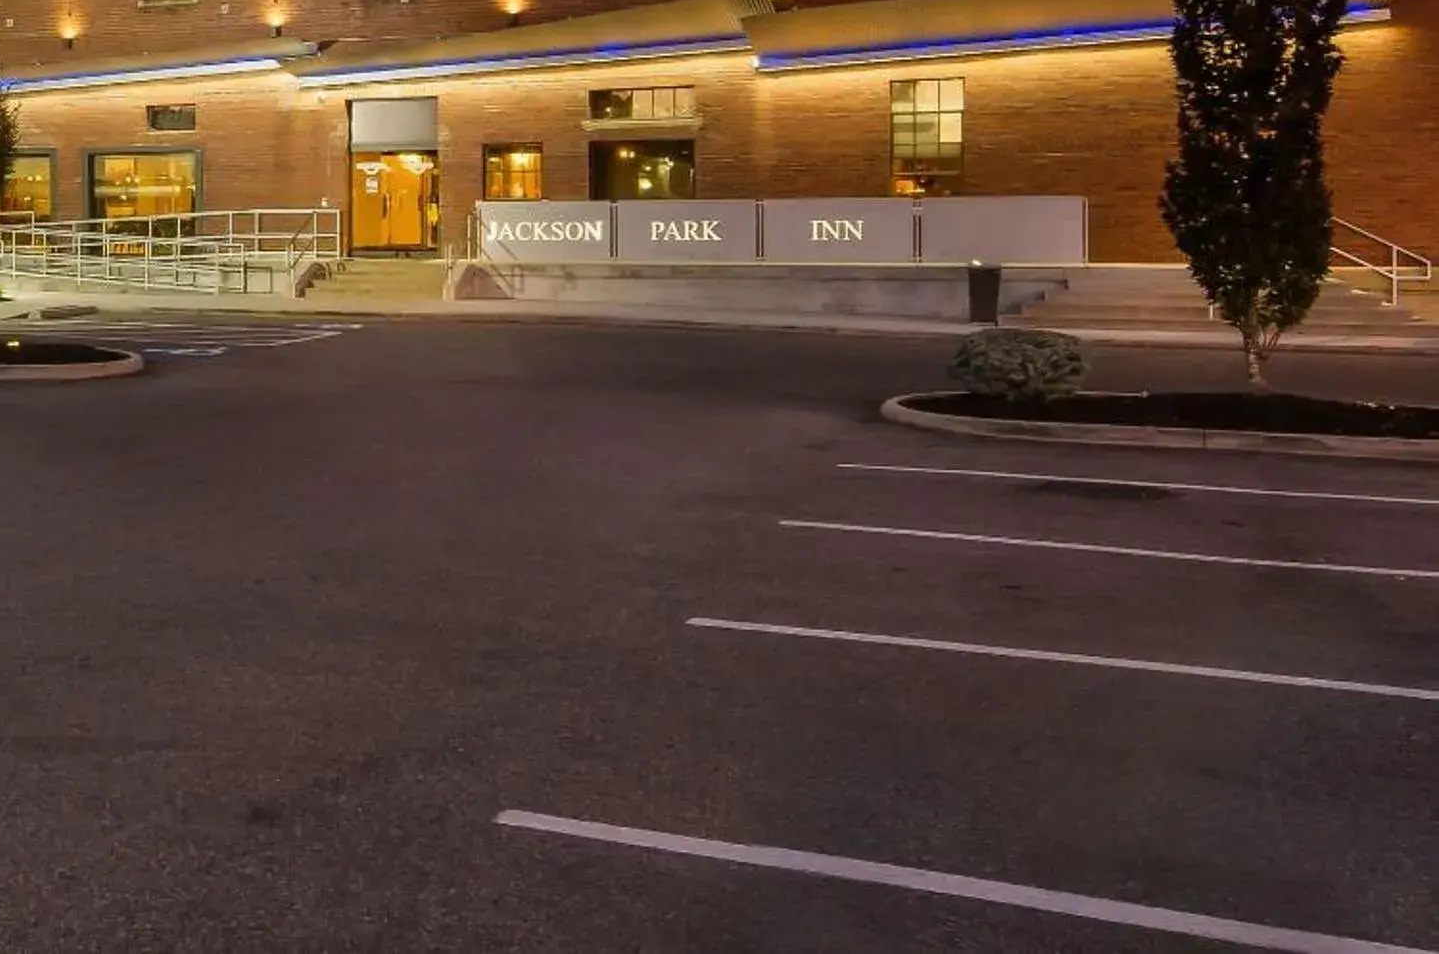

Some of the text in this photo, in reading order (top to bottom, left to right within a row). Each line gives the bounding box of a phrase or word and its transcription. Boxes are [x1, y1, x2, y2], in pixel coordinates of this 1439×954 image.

[486, 219, 864, 242] JACKSON PARK INN
